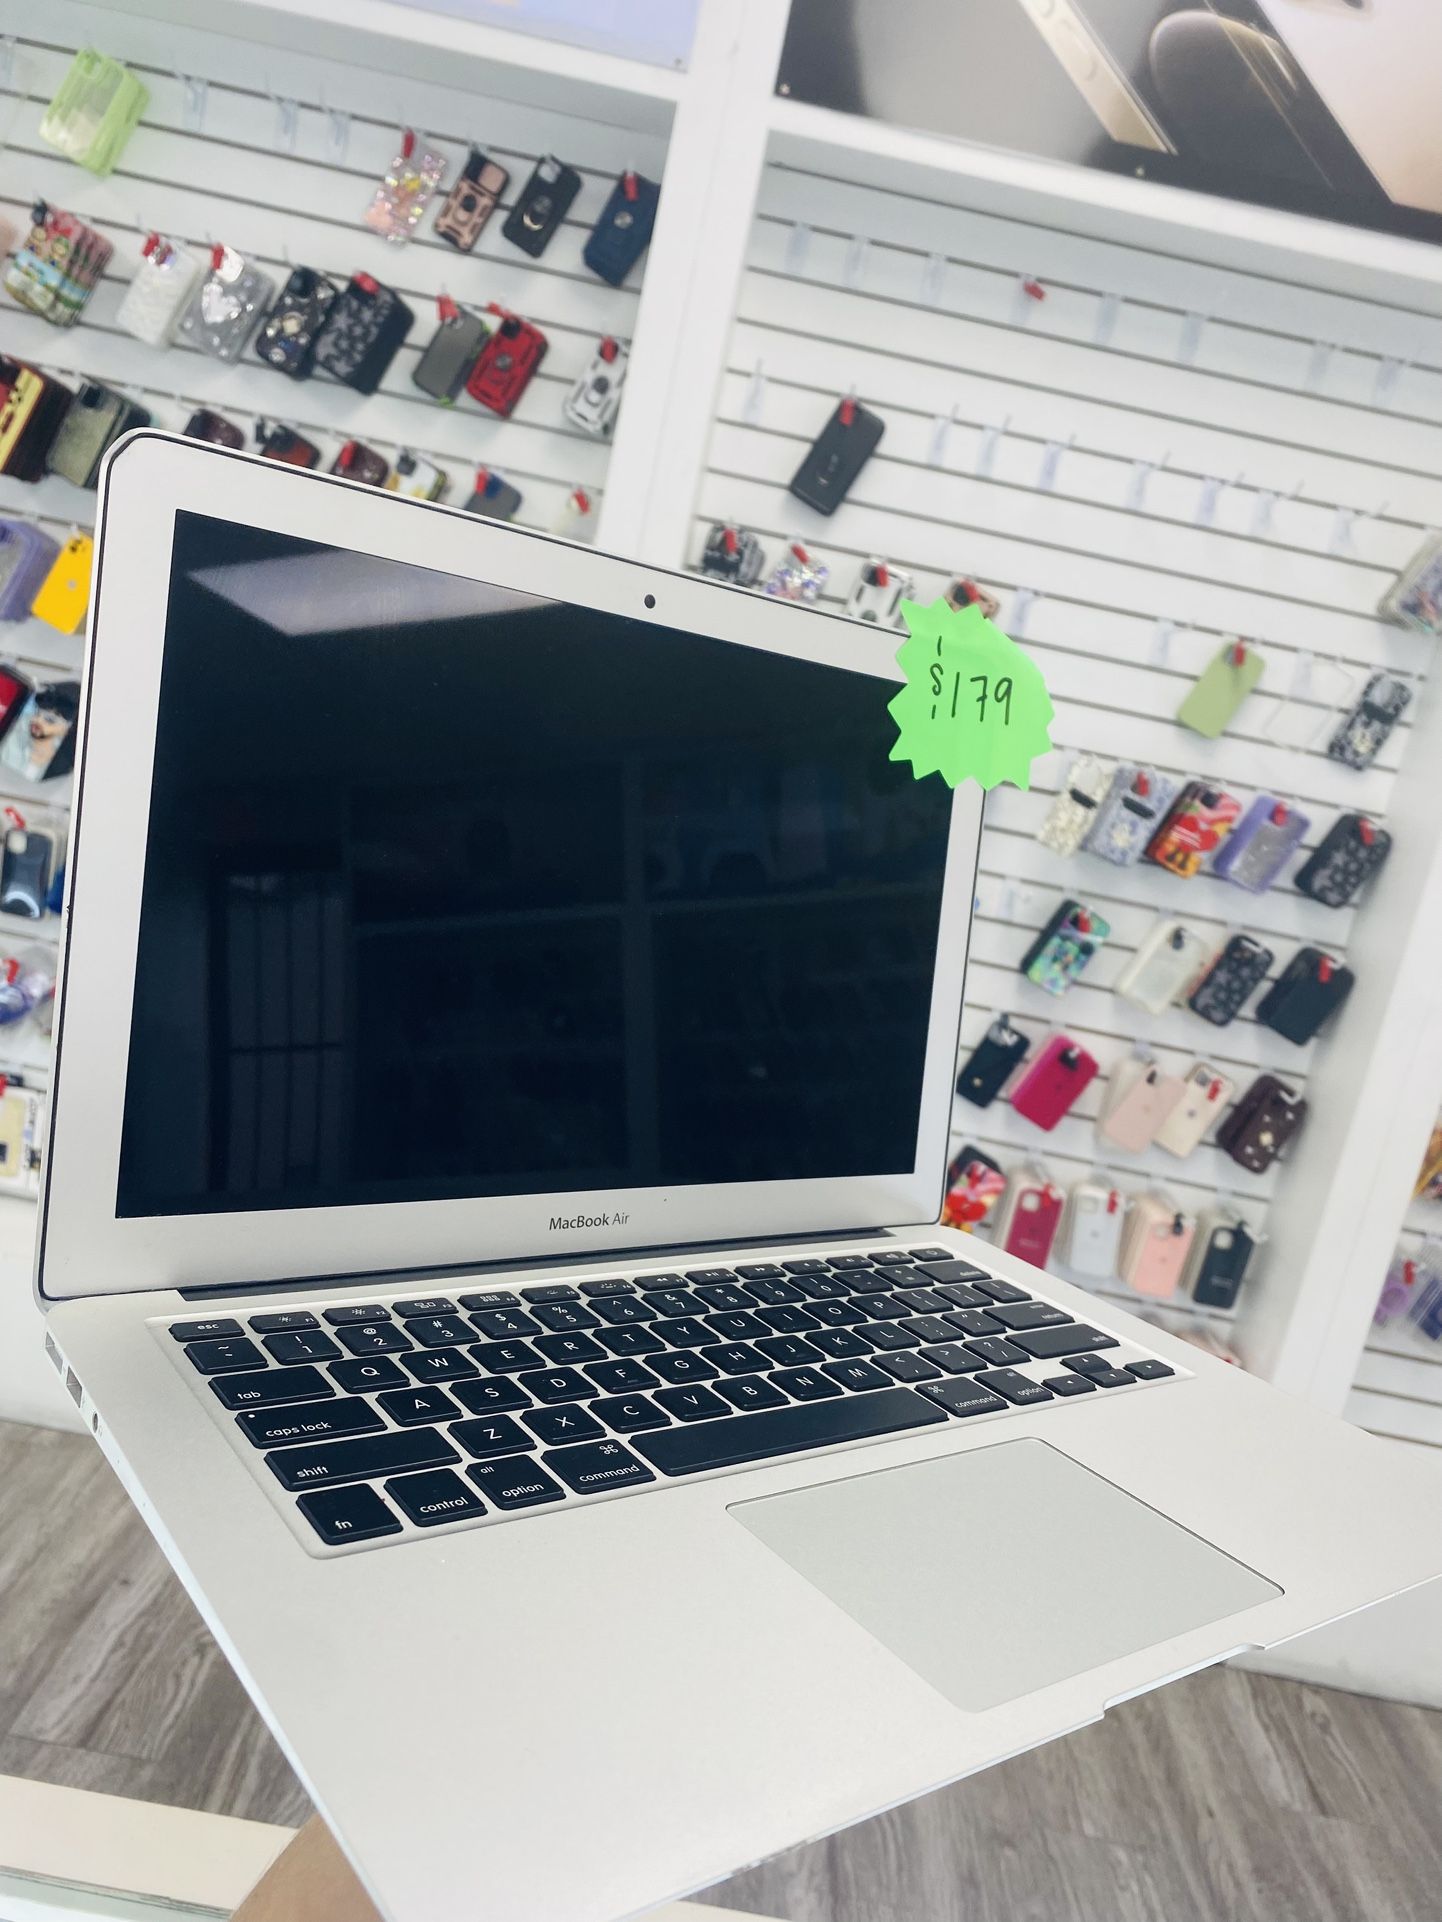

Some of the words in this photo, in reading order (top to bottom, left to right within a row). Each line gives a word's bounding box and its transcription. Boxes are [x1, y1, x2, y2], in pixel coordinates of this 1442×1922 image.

[930, 635, 1013, 726] $179
[548, 1212, 609, 1231] MacBook
[612, 1211, 630, 1226] Air
[873, 1301, 884, 1309] P
[624, 1308, 634, 1316] 6
[828, 1307, 842, 1315] O
[565, 1315, 577, 1323] 5
[730, 1319, 746, 1327] U
[197, 1322, 219, 1331] esc
[507, 1322, 518, 1330] 4
[676, 1326, 692, 1335] Y
[441, 1329, 454, 1338] 3
[622, 1333, 635, 1342] T
[879, 1330, 894, 1338] L
[373, 1338, 388, 1346] 2
[563, 1341, 579, 1350] R
[831, 1336, 849, 1345] K
[302, 1345, 313, 1354] 1
[786, 1344, 796, 1353] J
[500, 1350, 515, 1359] E
[728, 1352, 747, 1361] H
[428, 1357, 448, 1368] W
[674, 1360, 690, 1369] G
[360, 1366, 381, 1377] Q
[615, 1368, 627, 1378] F
[847, 1368, 868, 1378] M
[549, 1378, 566, 1388] D
[795, 1376, 815, 1386] N
[237, 1390, 261, 1400] tab
[484, 1387, 500, 1397] S
[742, 1386, 757, 1396] B
[414, 1399, 431, 1410] A
[683, 1395, 698, 1405] V
[954, 1395, 998, 1409] command
[623, 1405, 640, 1416] C
[554, 1416, 576, 1428] X
[265, 1424, 300, 1439] caps
[301, 1420, 332, 1432] lock
[482, 1428, 503, 1440] Z
[296, 1465, 329, 1479] shift
[480, 1465, 495, 1475] alt
[578, 1463, 641, 1483] command
[501, 1482, 545, 1498] option
[420, 1496, 469, 1514] control
[334, 1519, 353, 1531] fn
